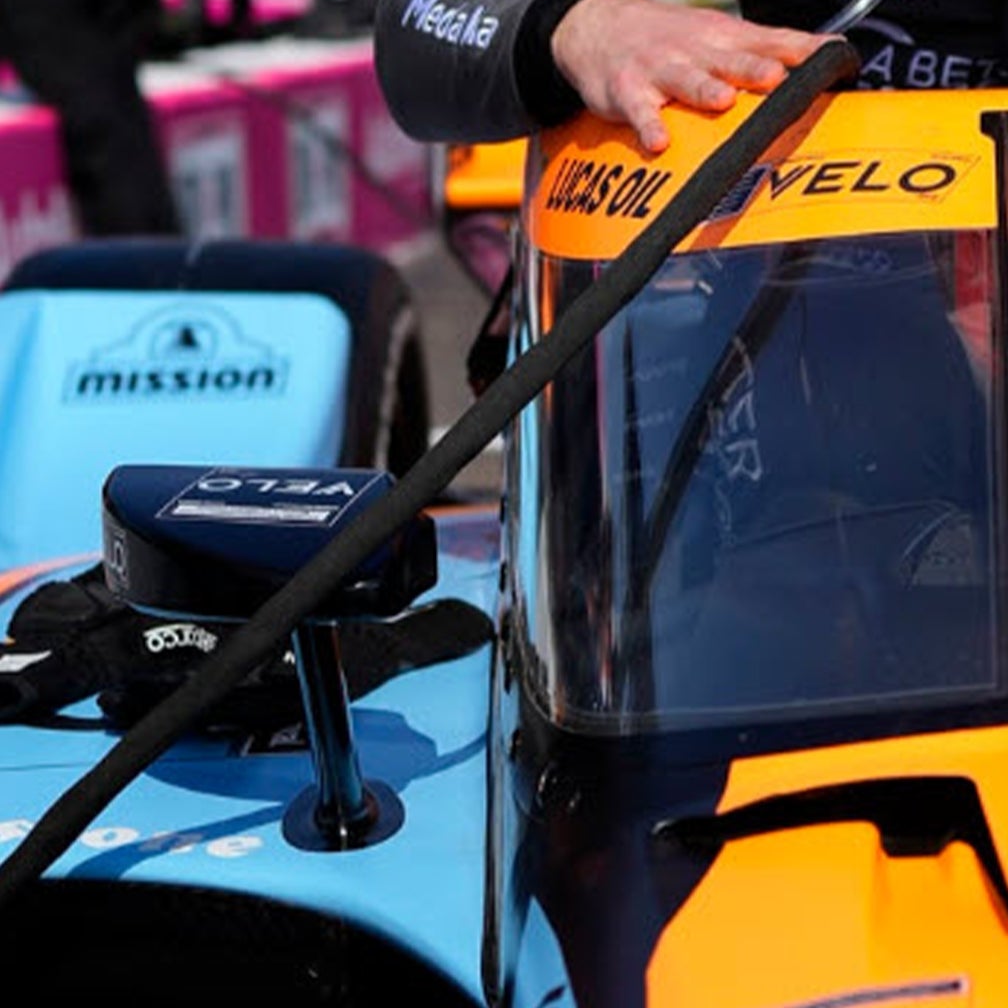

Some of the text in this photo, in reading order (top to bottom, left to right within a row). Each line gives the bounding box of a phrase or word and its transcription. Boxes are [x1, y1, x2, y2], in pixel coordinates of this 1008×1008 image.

[861, 44, 893, 84] A
[546, 159, 624, 215] LUCAS
[607, 169, 671, 219] OIL
[768, 160, 957, 200] VELO
[77, 364, 275, 398] mission
[199, 478, 355, 497] VELO
